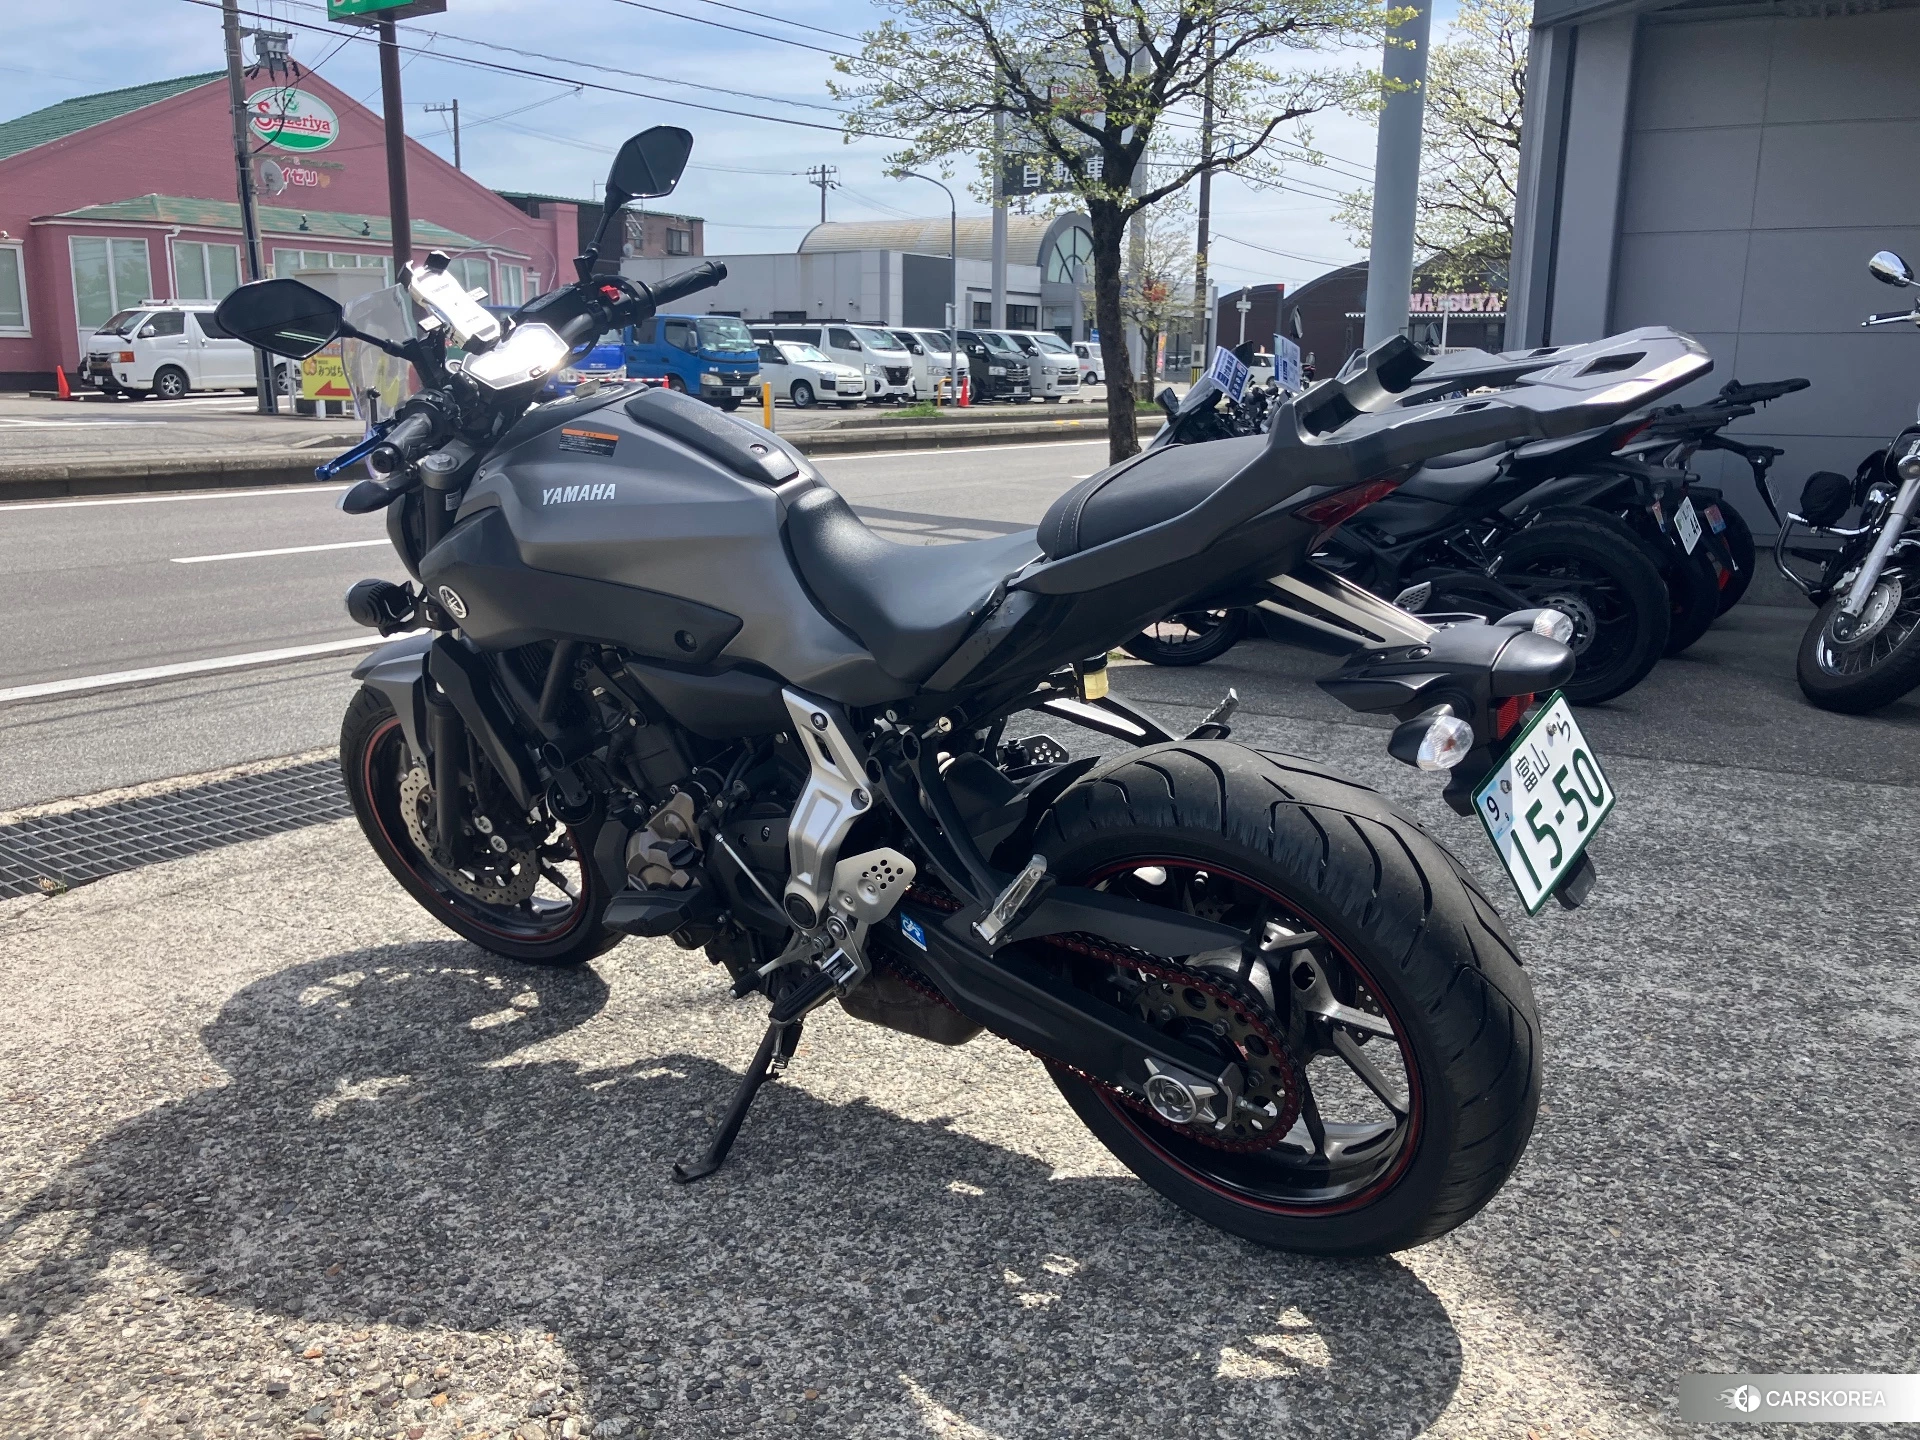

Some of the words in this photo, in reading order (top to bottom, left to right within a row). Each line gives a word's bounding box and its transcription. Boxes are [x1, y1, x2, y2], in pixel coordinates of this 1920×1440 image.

[256, 102, 330, 132] Sazeriya
[1410, 292, 1501, 312] MATSUYA
[543, 483, 616, 506] YAMAHA
[1515, 743, 1551, 793] 富山
[1486, 795, 1500, 822] 9
[1510, 748, 1605, 892] 15-50
